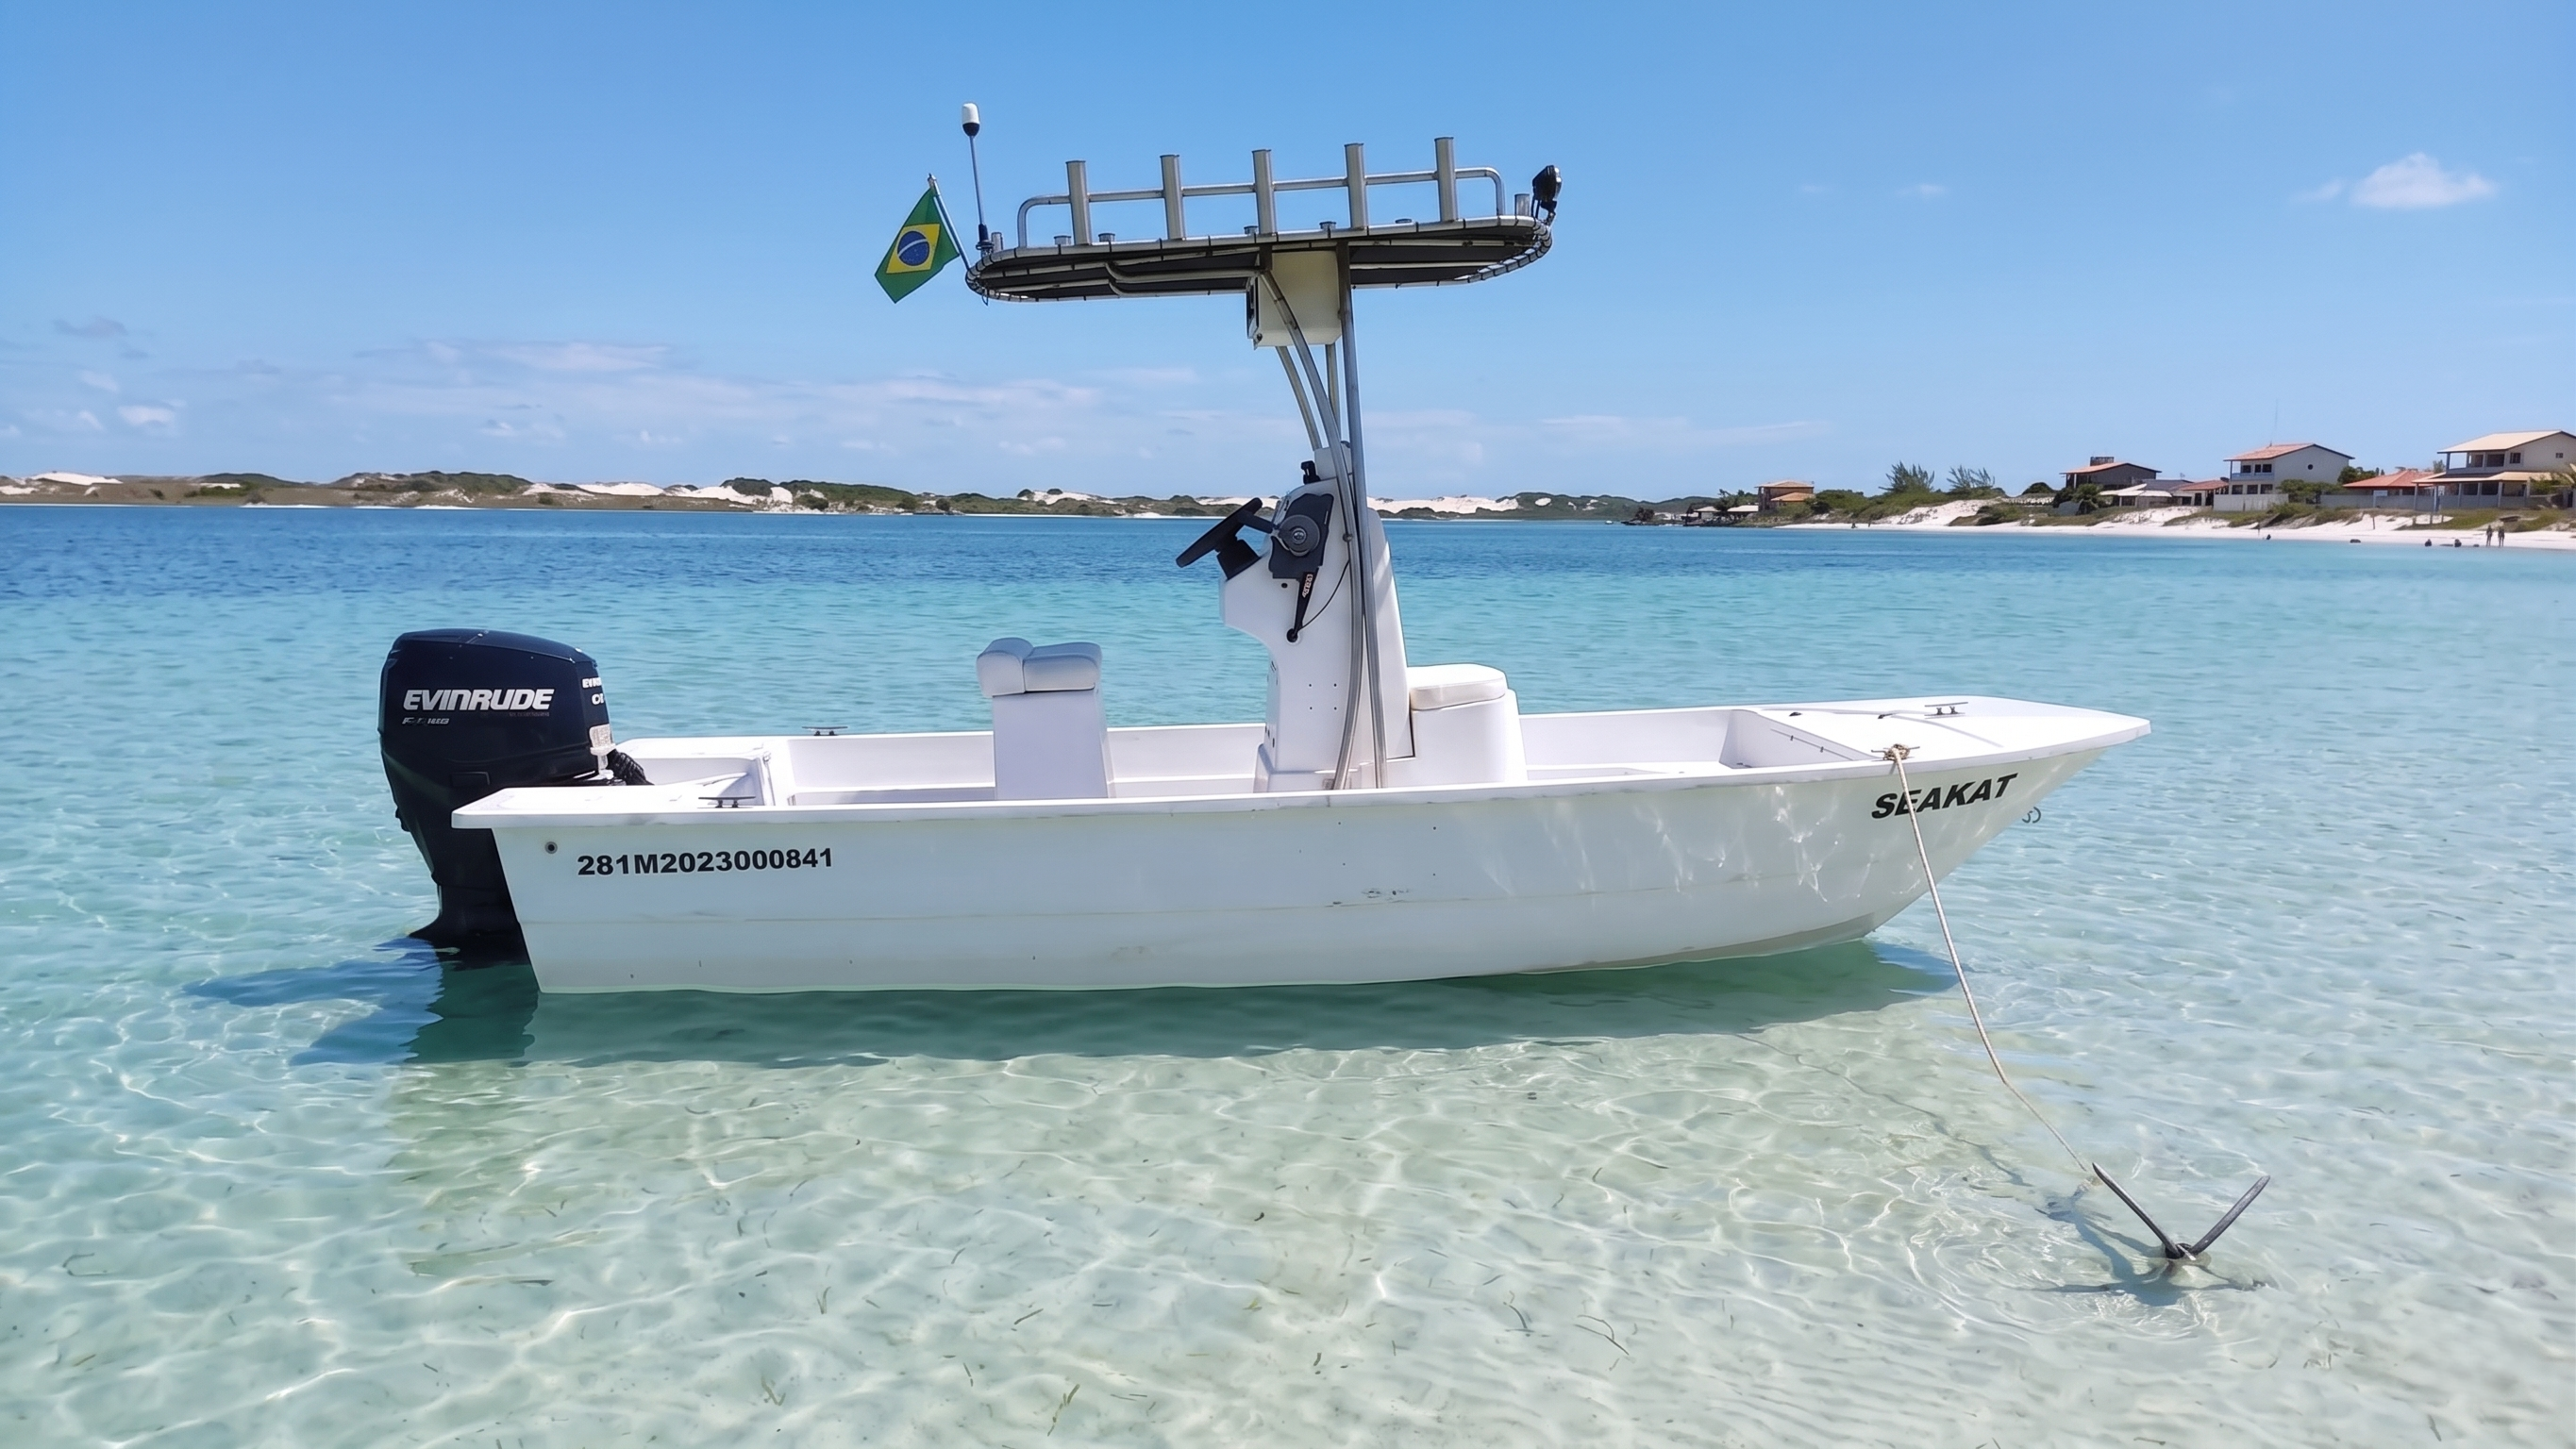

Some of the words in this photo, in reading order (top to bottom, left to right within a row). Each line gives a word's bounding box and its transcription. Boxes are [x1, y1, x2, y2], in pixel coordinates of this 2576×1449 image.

[403, 689, 555, 710] EVINRUDE
[1872, 773, 2018, 819] SEAKAT
[577, 847, 832, 875] 281M2023000841
